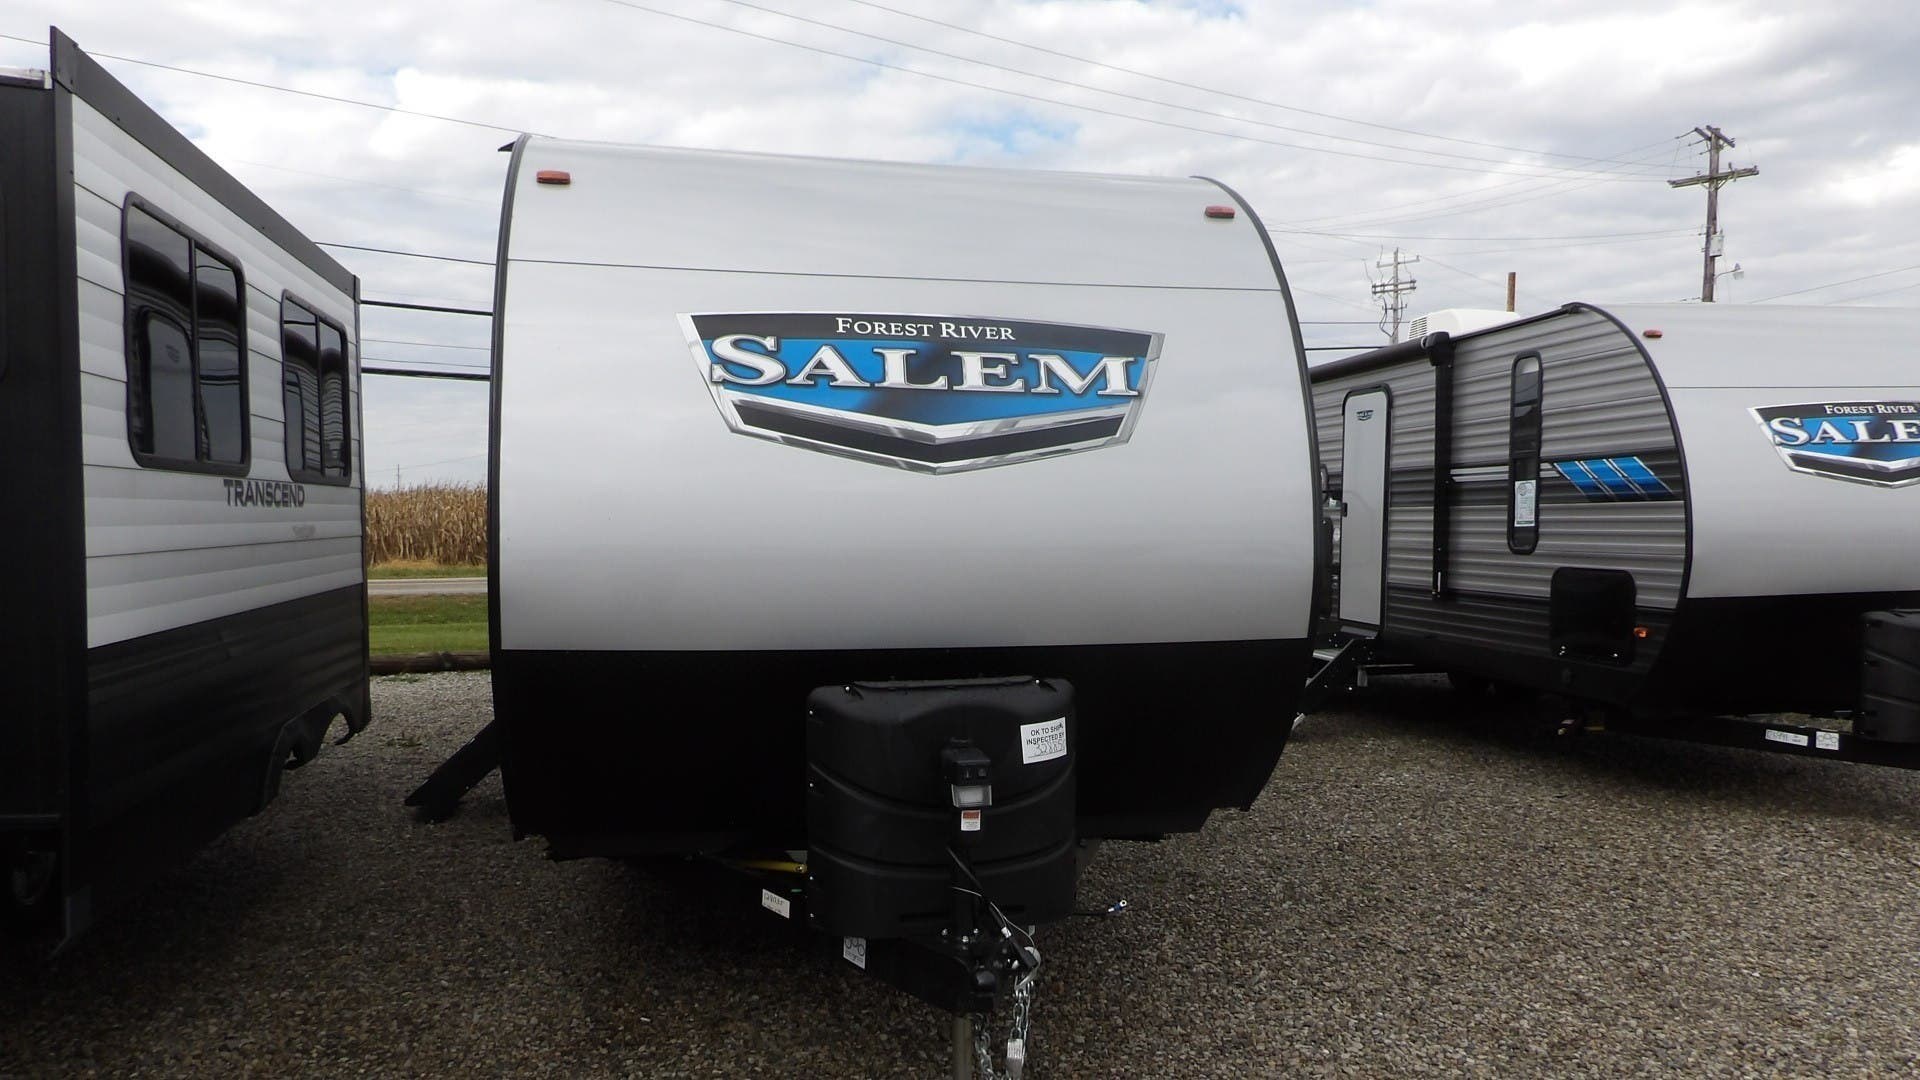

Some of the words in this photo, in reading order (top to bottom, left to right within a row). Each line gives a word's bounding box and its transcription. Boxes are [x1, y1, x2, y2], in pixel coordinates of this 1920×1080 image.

[835, 317, 933, 338] FOREST
[940, 320, 1016, 341] RIVER
[711, 333, 1140, 397] SALEM
[1824, 404, 1875, 415] FOREST
[1876, 404, 1917, 414] RIVER
[223, 478, 306, 508] TRANSCEND
[1026, 733, 1059, 746] INSPECTED
[1030, 728, 1040, 737] OK
[1041, 727, 1050, 735] TO
